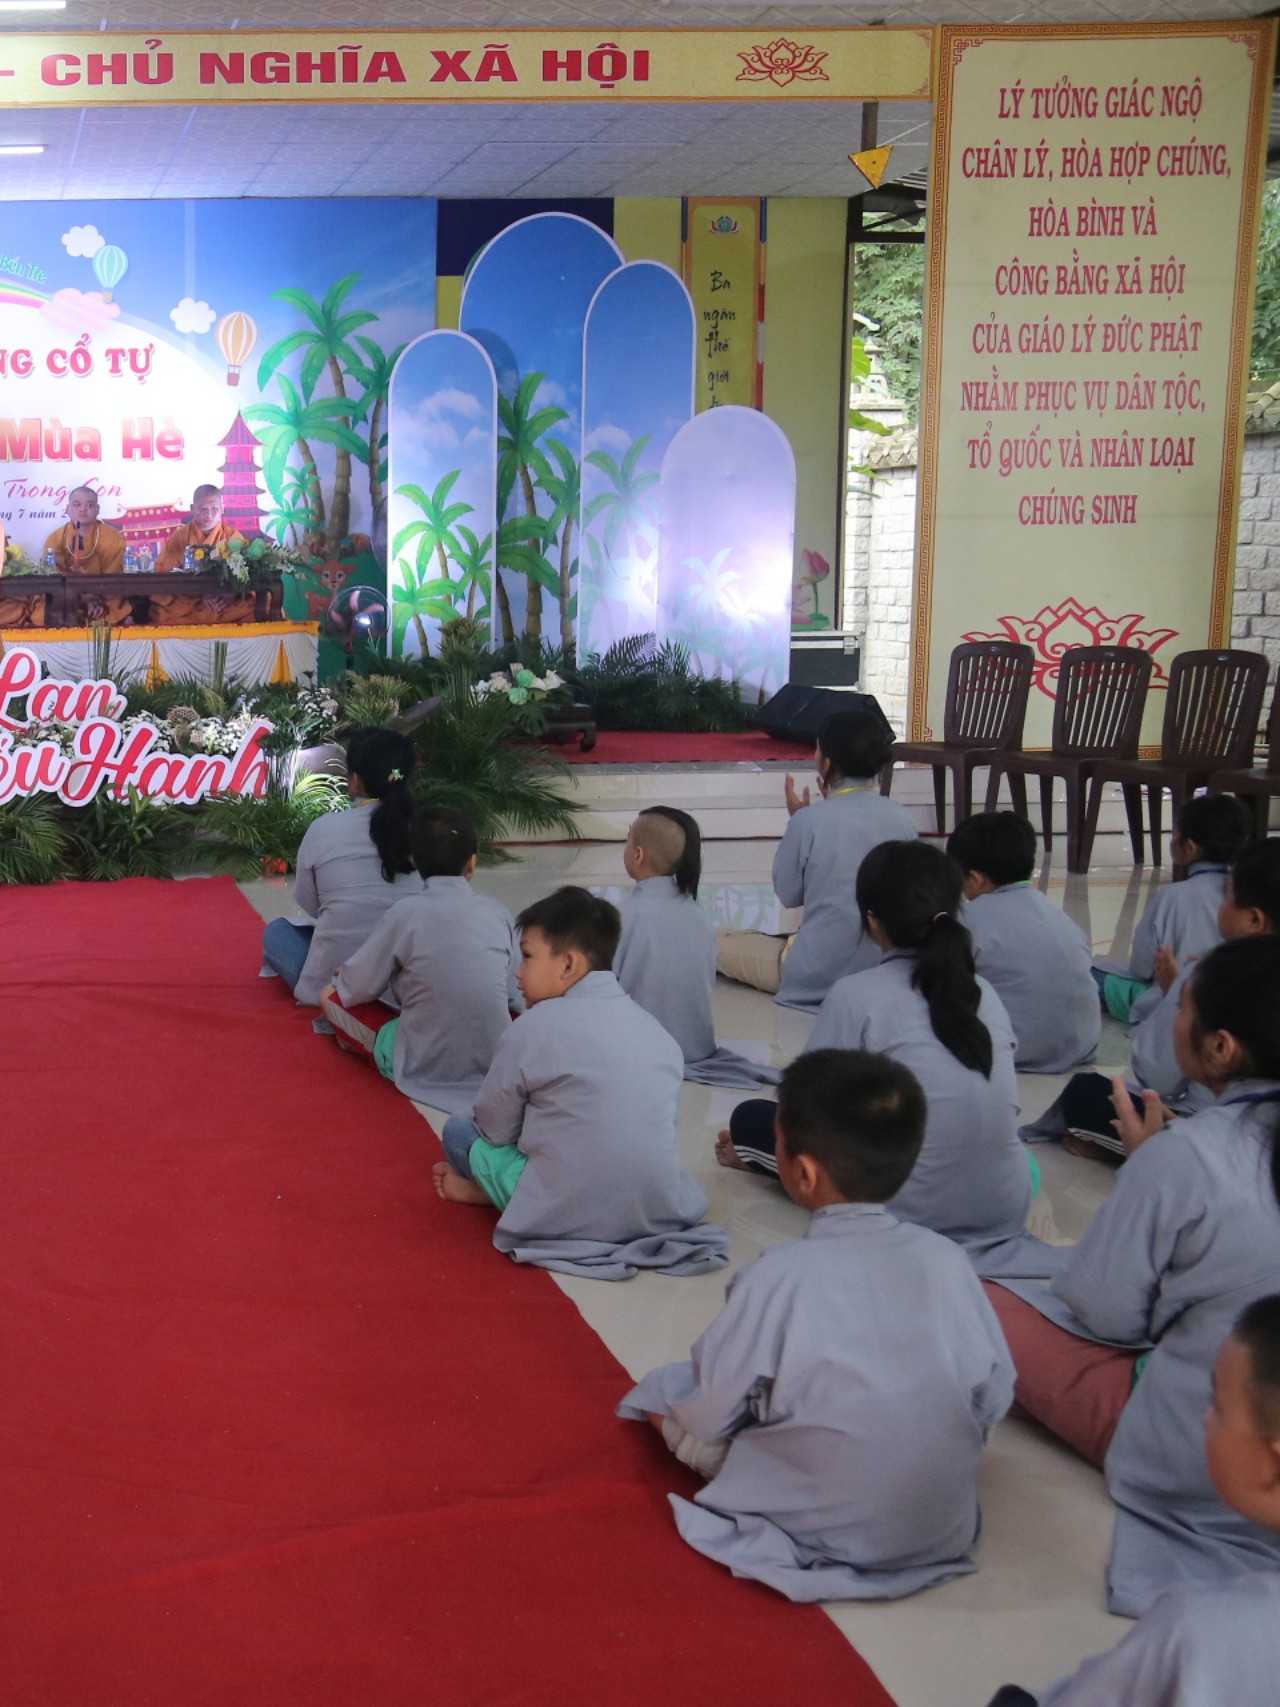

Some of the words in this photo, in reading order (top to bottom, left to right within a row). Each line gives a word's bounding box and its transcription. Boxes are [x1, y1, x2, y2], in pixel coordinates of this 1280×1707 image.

[42, 40, 174, 86] CHỦ
[200, 44, 407, 84] NGHĨA
[430, 44, 519, 82] XÃ
[542, 42, 650, 89] HỘI
[998, 79, 1025, 119] LÝ
[1031, 75, 1099, 119] TƯỞNG
[1105, 77, 1155, 118] GIÁC
[1160, 76, 1202, 124] NGỘ
[962, 138, 1018, 179] CHÂN
[1023, 138, 1053, 182] LÝ,
[1060, 137, 1103, 178] HÒA
[1108, 141, 1151, 185] HỢP
[1156, 136, 1231, 179] CHÚNG,
[1028, 197, 1070, 237] HÒA
[1075, 197, 1125, 236] BÌNH
[1131, 196, 1158, 236] VÀ
[27, 262, 48, 285] Tre
[710, 270, 731, 292] Ba
[995, 256, 1049, 296] CÔNG
[1055, 248, 1109, 296] BẰNG
[1149, 255, 1186, 301] HỘI
[46, 333, 93, 376] CỔ
[104, 343, 154, 382] TỰ
[972, 312, 1012, 354] CỦA
[1018, 314, 1065, 353] GIÁO
[1071, 314, 1096, 353] LÝ
[1102, 314, 1143, 353] ĐỨC
[1149, 313, 1202, 359] PHẬT
[960, 364, 1018, 411] NHẰM
[1024, 381, 1077, 418] PHỤC
[1083, 381, 1109, 418] VỤ
[1115, 372, 1156, 410] DÂN
[1162, 371, 1206, 416] TỘC,
[120, 416, 186, 461] Hè
[967, 421, 993, 469] TỔ
[999, 424, 1052, 477] QUỐC
[1058, 430, 1084, 468] VÀ
[1090, 429, 1144, 468] NHÂN
[1150, 437, 1196, 474] LOẠI
[3, 478, 70, 506] Trong
[18, 509, 26, 519] 7
[1018, 486, 1086, 526] CHÚNG
[1091, 495, 1138, 525] SINH
